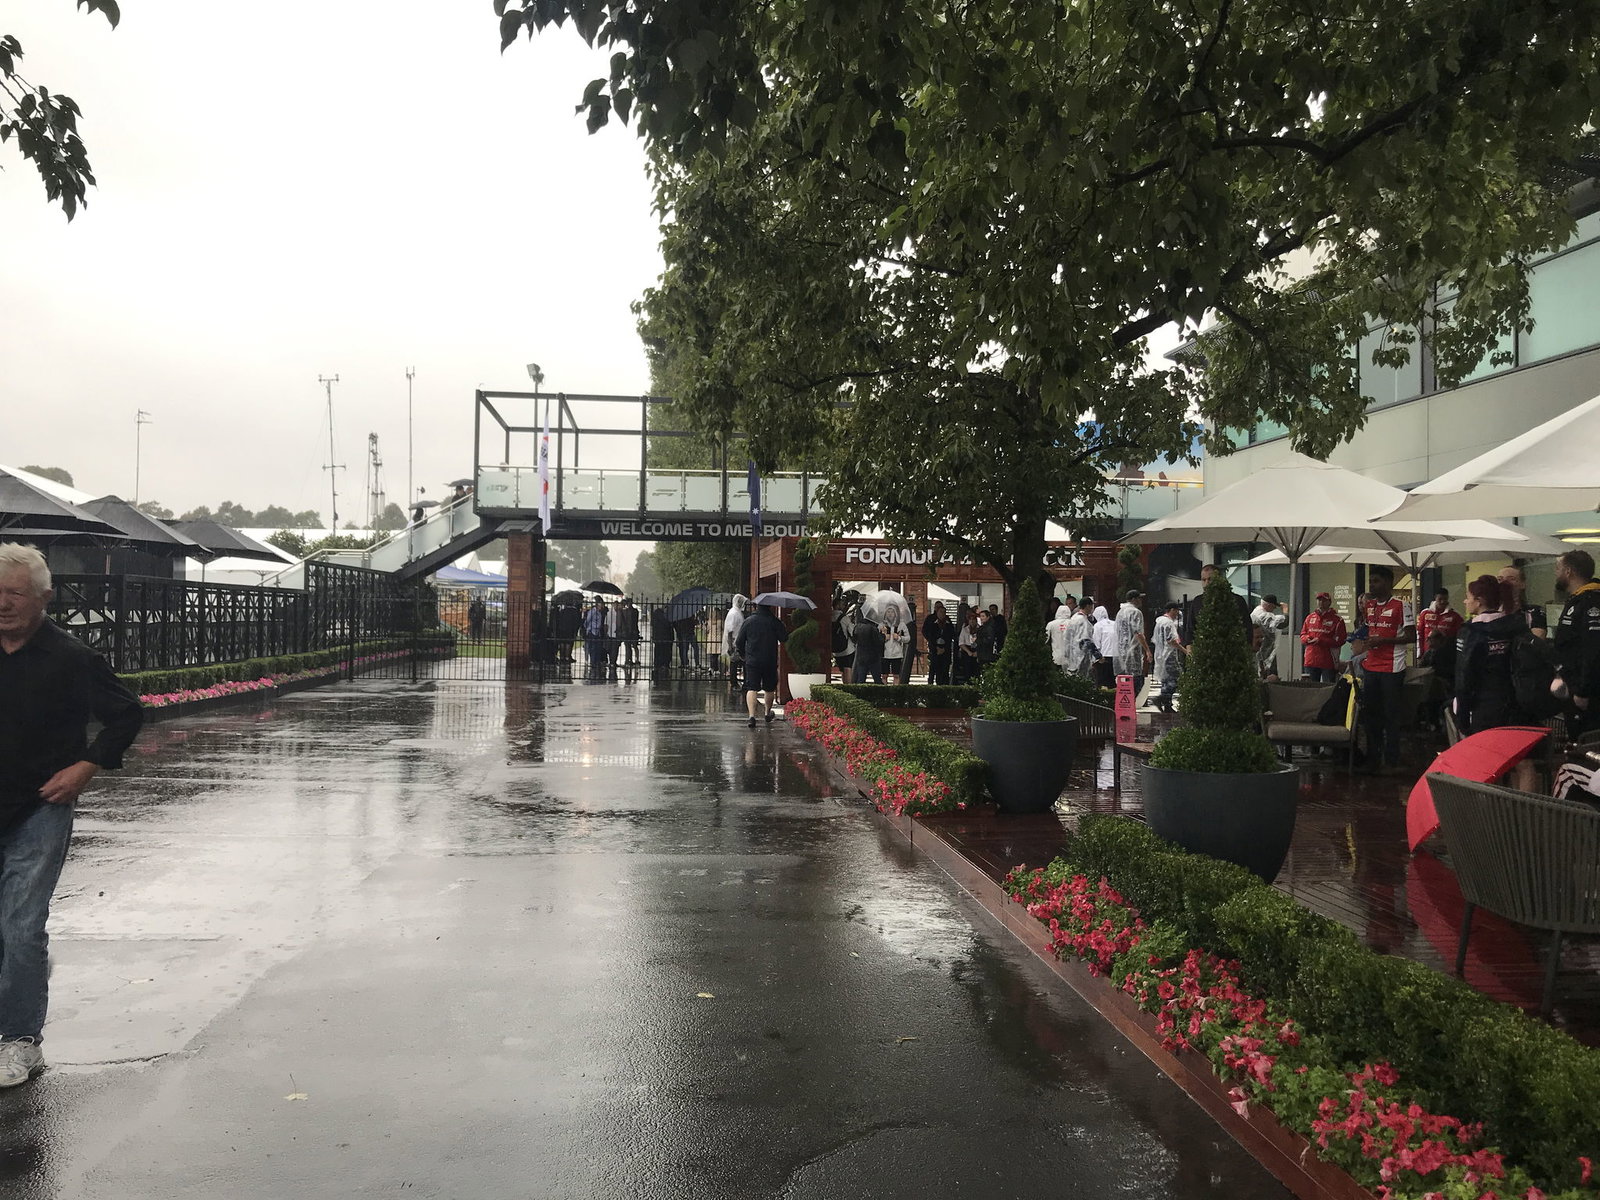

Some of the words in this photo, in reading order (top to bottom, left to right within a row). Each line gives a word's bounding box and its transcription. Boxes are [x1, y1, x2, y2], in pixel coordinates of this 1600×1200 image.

[601, 521, 693, 536] WELCOME
[697, 523, 721, 537] TO
[846, 547, 956, 565] FORMULA
